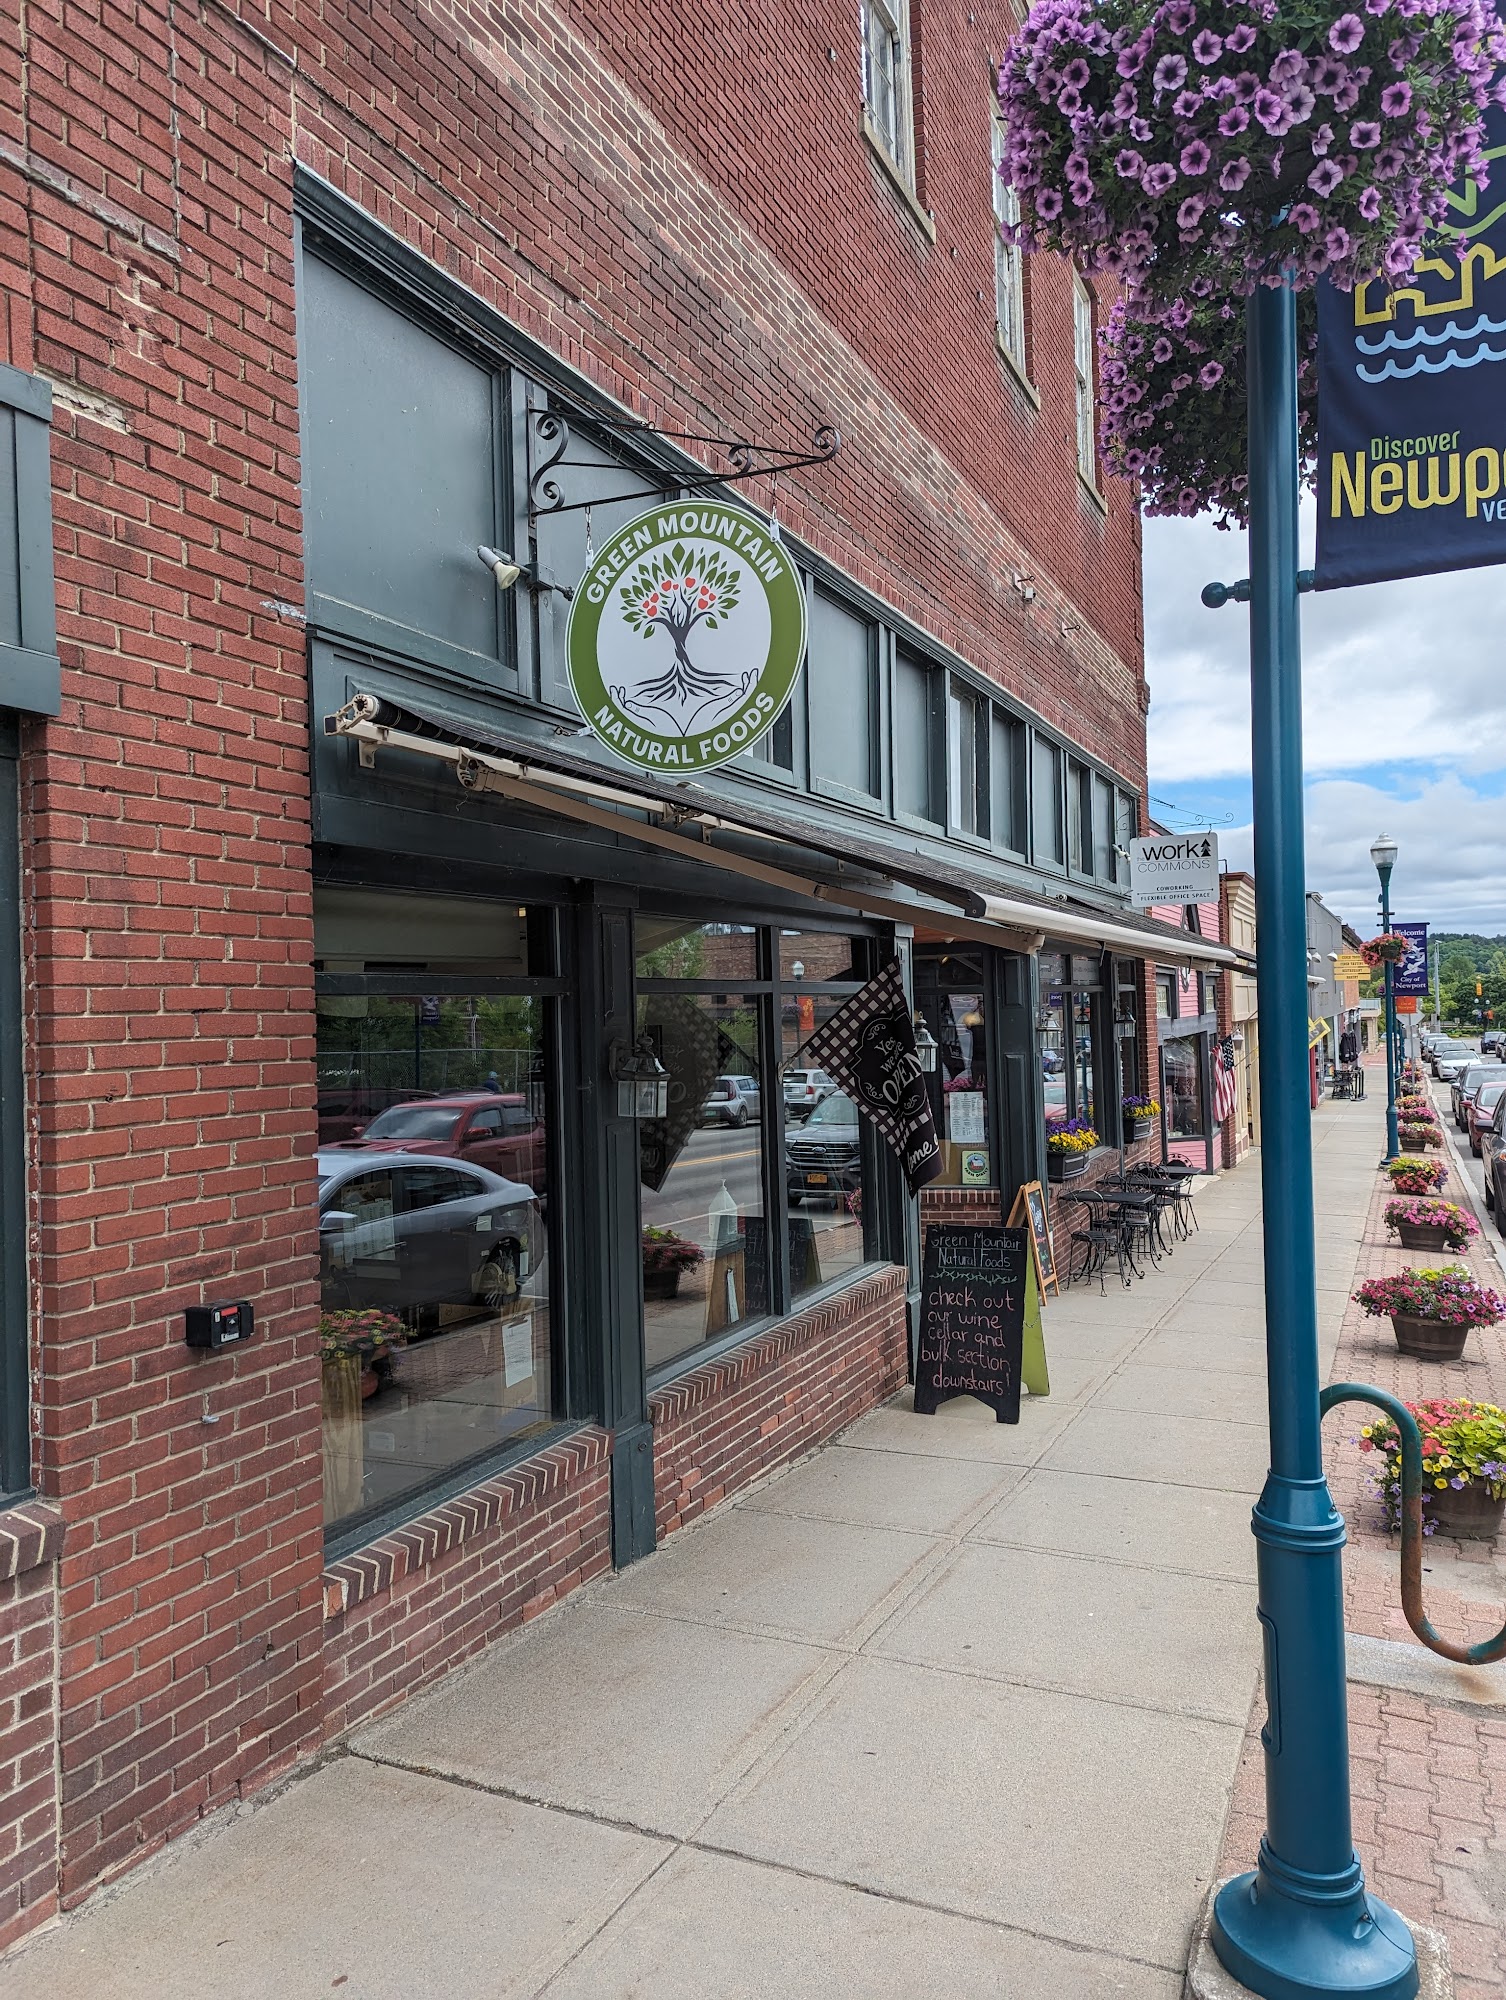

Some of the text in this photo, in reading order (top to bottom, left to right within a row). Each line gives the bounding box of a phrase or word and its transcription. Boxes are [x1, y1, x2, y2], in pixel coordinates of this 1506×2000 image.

[1371, 431, 1460, 461] Discover
[1330, 447, 1506, 518] Newp
[586, 511, 783, 604] GREEN MOUNTAIN
[593, 692, 774, 764] NATURAL FOODS
[1142, 840, 1200, 861] work
[1138, 860, 1210, 873] COMMONS
[883, 1046, 922, 1104] OPEN
[930, 1235, 968, 1248] Green
[938, 1247, 1012, 1268] Natural Foods
[928, 1285, 1016, 1312] check out
[927, 1310, 1003, 1330] our wine
[927, 1322, 1007, 1349] cellar and
[921, 1338, 1012, 1373] bulk section
